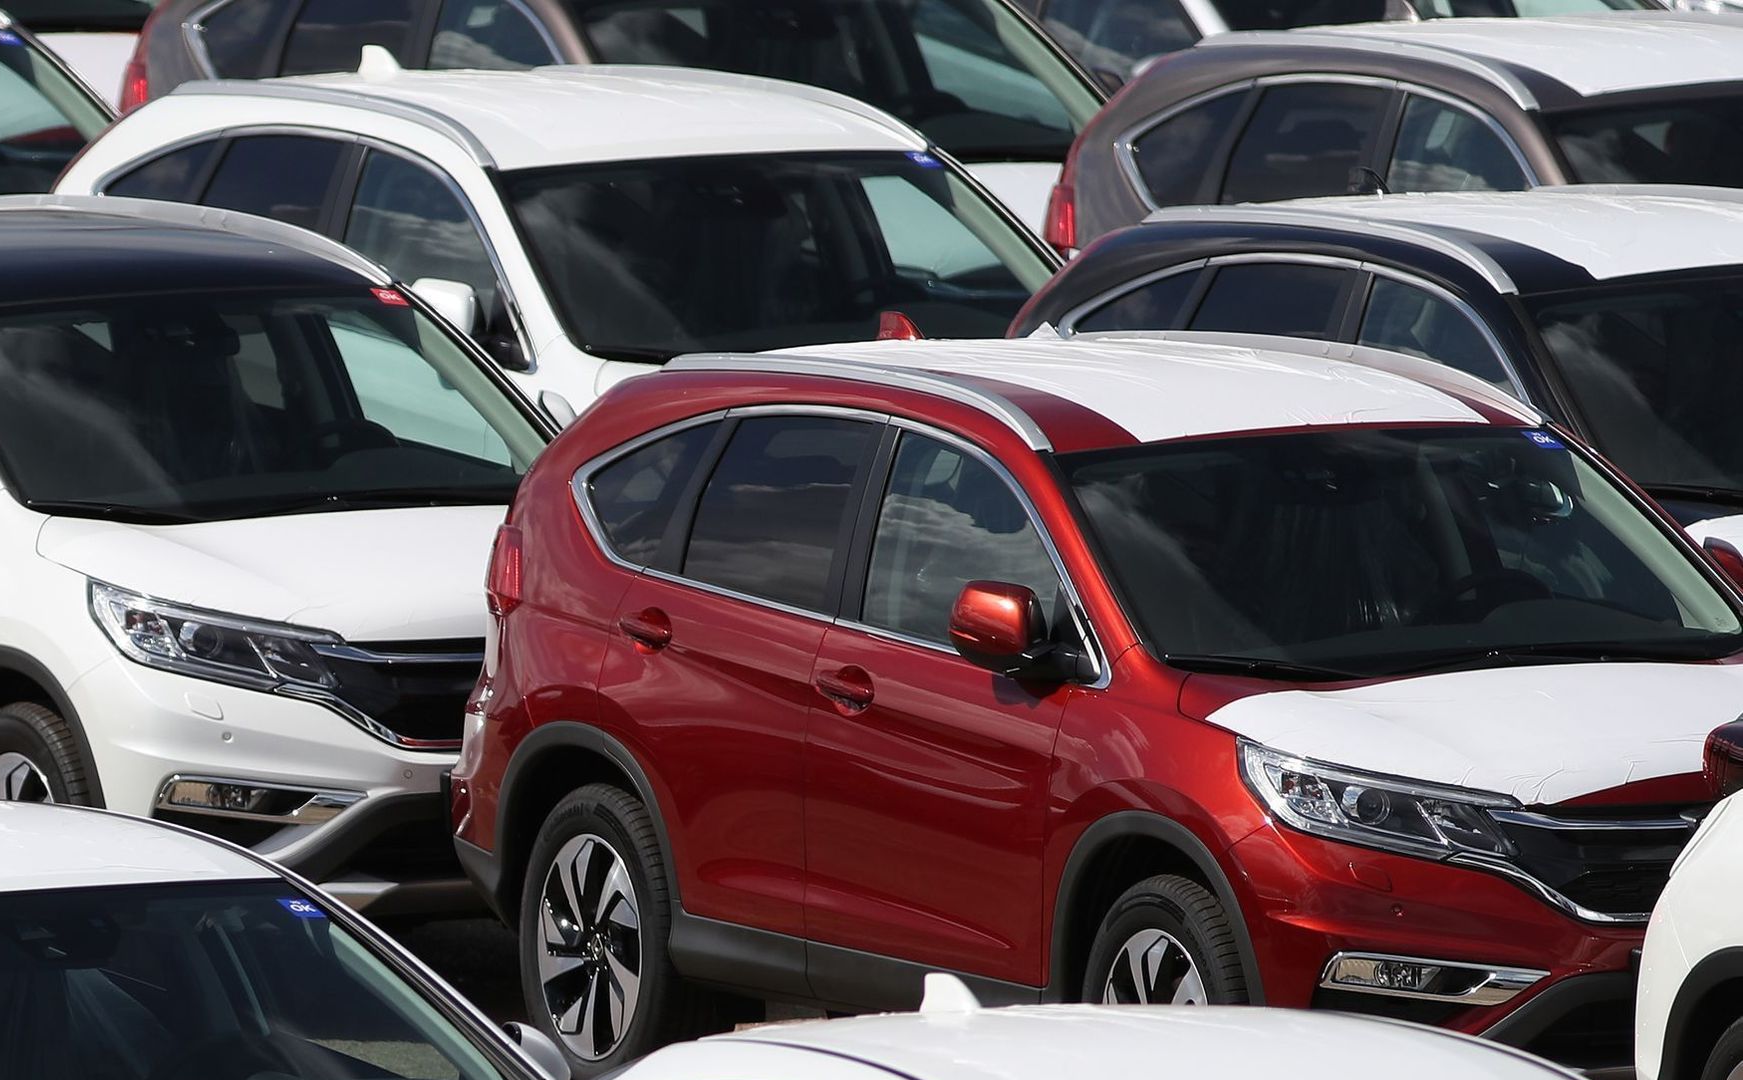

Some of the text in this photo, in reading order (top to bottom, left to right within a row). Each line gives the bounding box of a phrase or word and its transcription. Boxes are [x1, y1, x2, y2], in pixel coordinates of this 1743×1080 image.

[377, 292, 401, 301] OK
[1533, 435, 1556, 444] OK
[289, 904, 317, 913] OK
